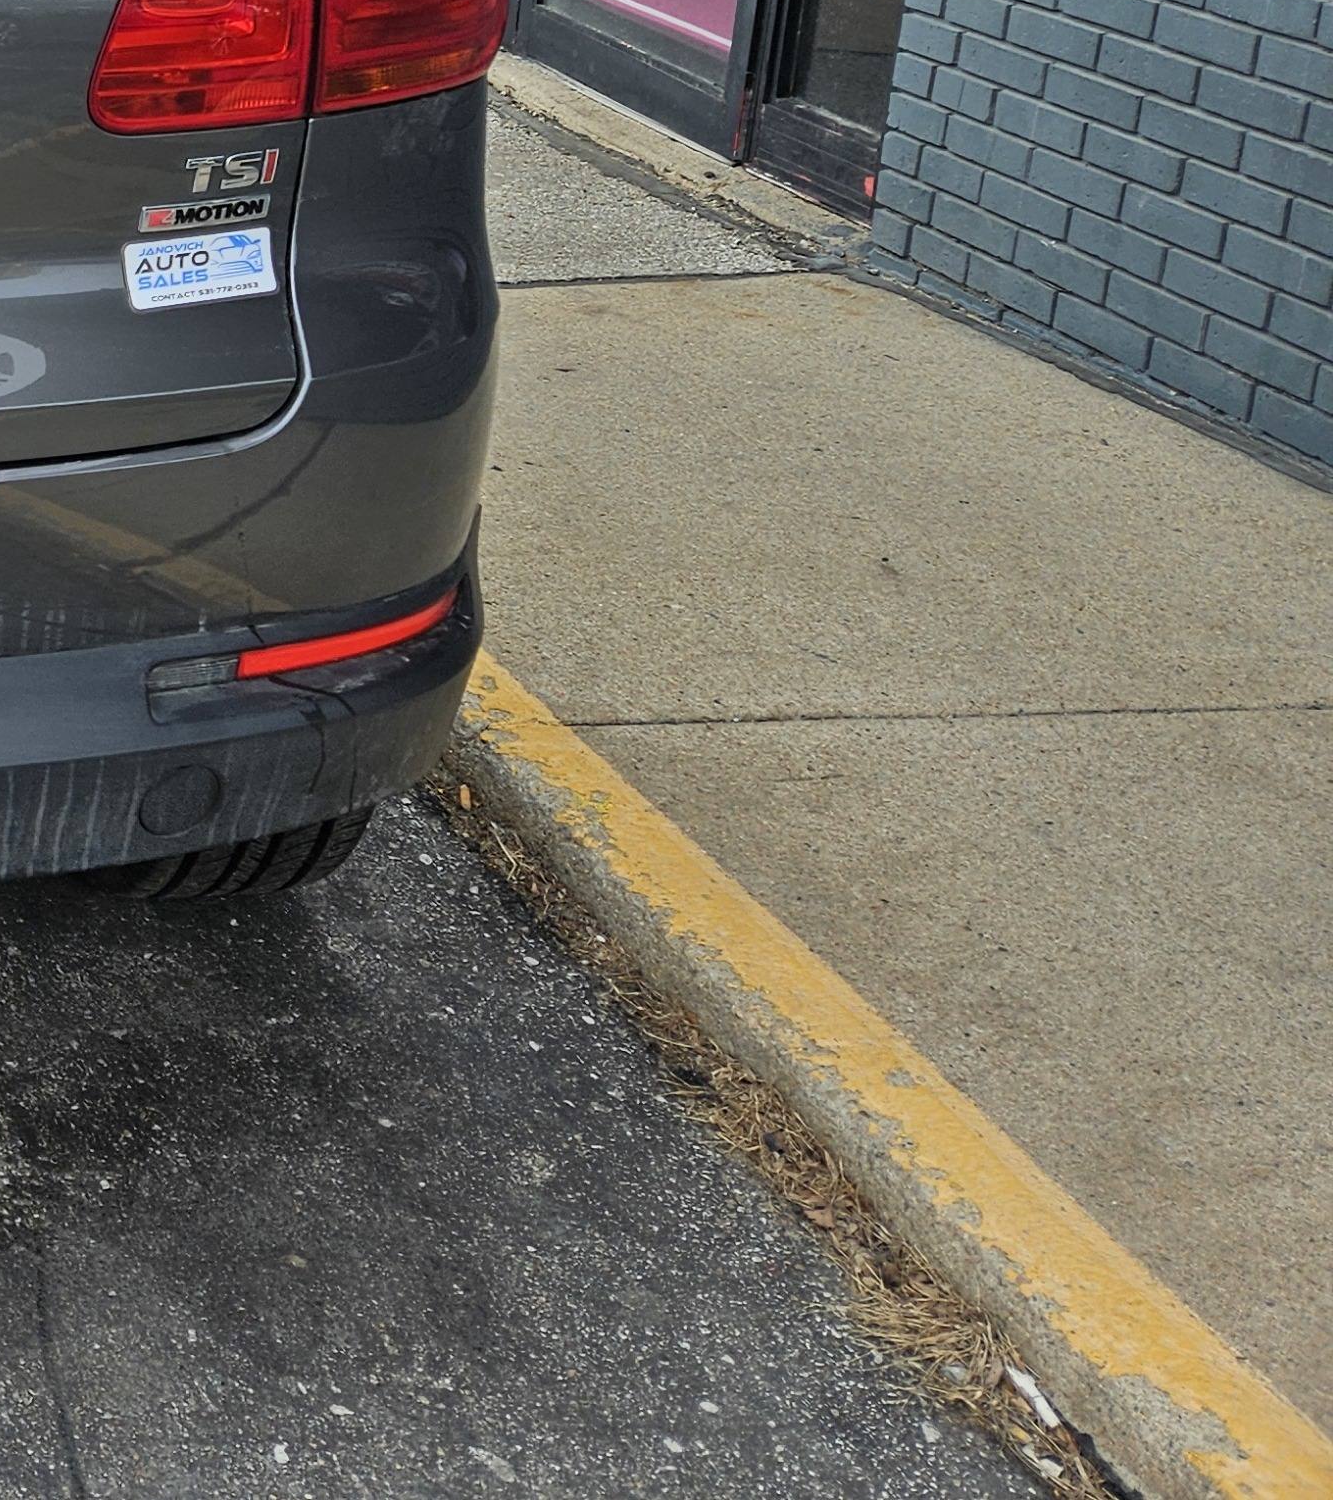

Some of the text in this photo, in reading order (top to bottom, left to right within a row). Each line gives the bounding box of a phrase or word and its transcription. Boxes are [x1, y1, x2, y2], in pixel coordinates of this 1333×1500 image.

[186, 148, 279, 193] TSI
[139, 241, 204, 257] JANOVICH
[135, 251, 210, 275] AUTO
[138, 268, 209, 290] SALES
[151, 282, 259, 302] CONTACT 531-772-0353
